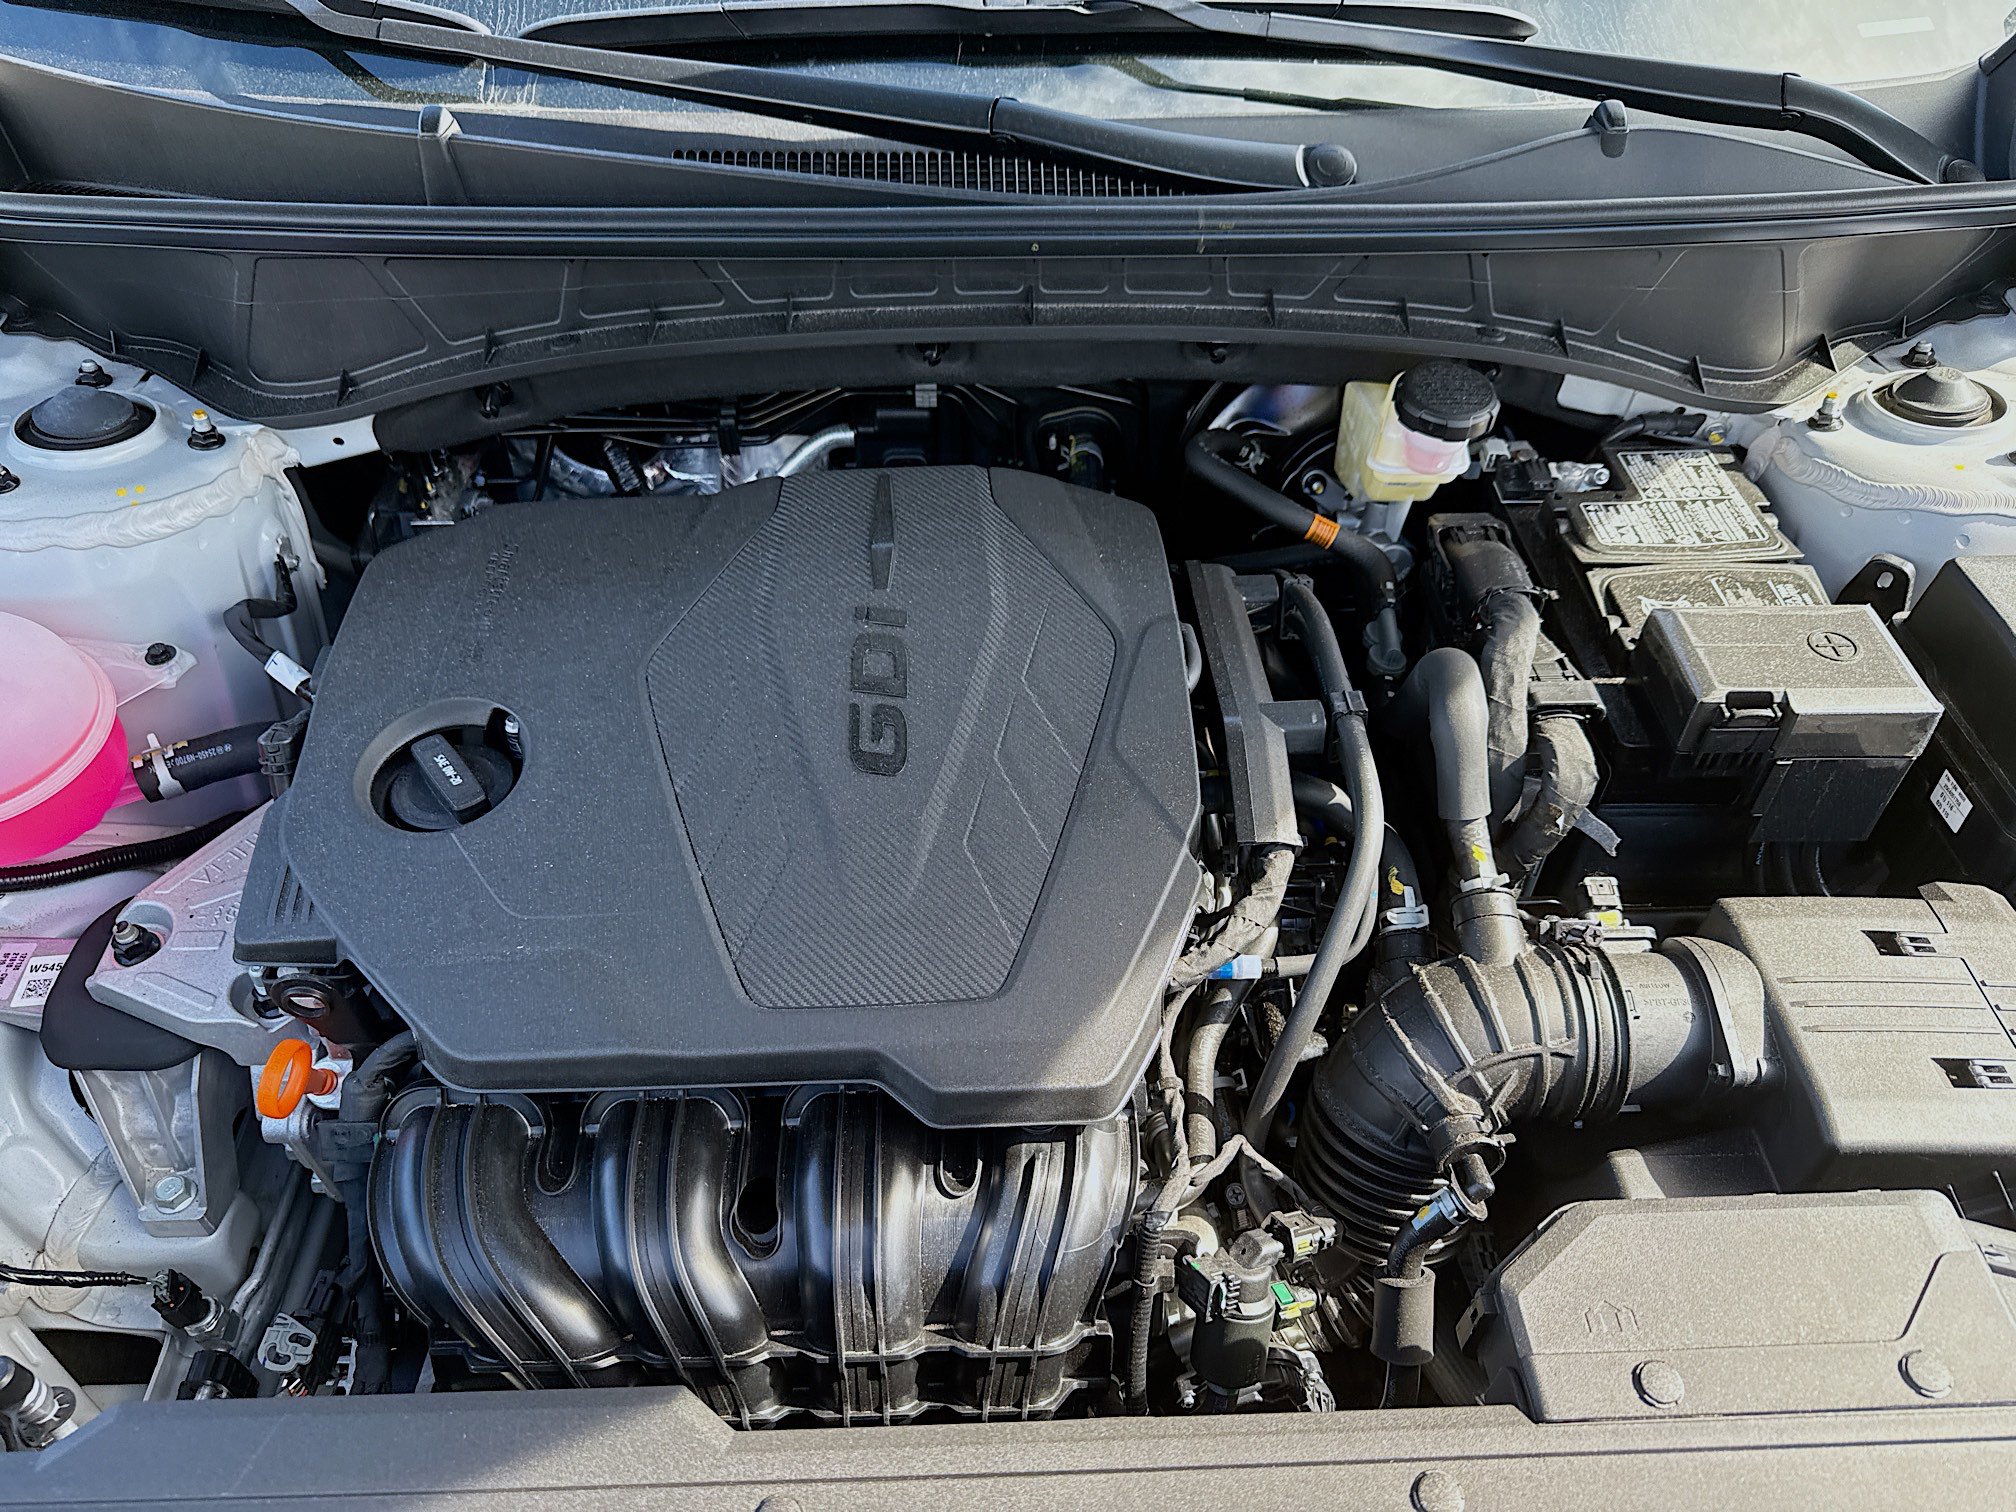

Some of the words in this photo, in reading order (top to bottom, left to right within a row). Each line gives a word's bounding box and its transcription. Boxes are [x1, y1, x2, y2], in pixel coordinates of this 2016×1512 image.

[433, 754, 450, 768] SAE
[442, 765, 463, 786] 0W-20
[30, 962, 63, 973] W545
